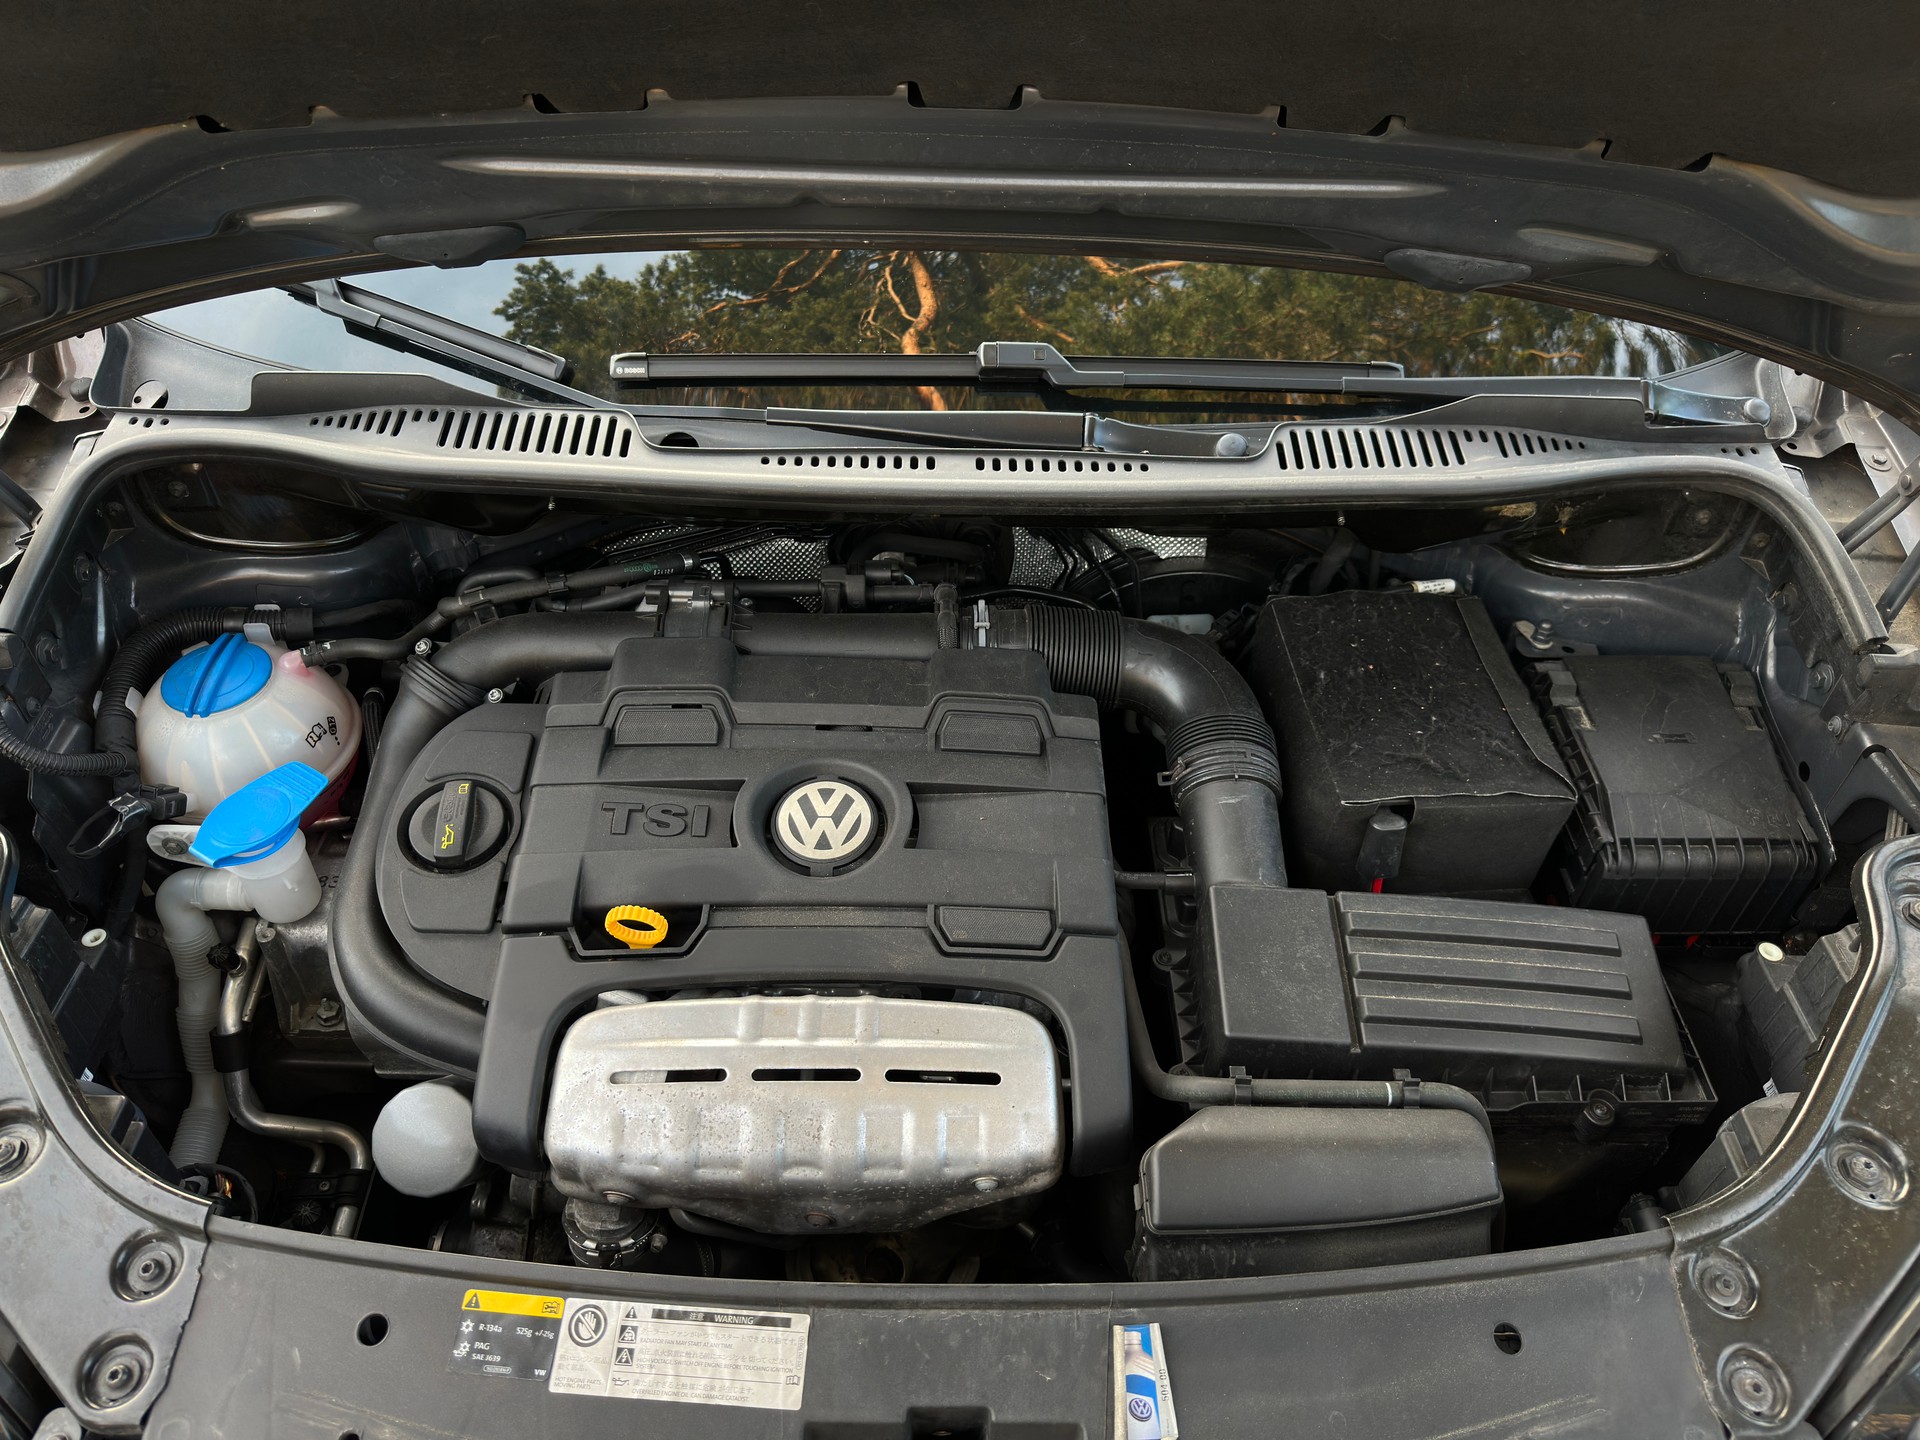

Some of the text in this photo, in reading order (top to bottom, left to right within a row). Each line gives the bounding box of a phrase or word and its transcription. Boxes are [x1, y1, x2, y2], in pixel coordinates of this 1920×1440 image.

[601, 801, 711, 838] TSI
[777, 780, 872, 860] VW
[714, 1314, 754, 1325] WARNING
[478, 1323, 503, 1333] R-134a
[515, 1326, 533, 1338] 525g
[474, 1341, 491, 1351] PAG
[471, 1353, 501, 1362] SAE J639
[534, 1368, 547, 1376] VW
[1159, 1368, 1169, 1402] 504 00
